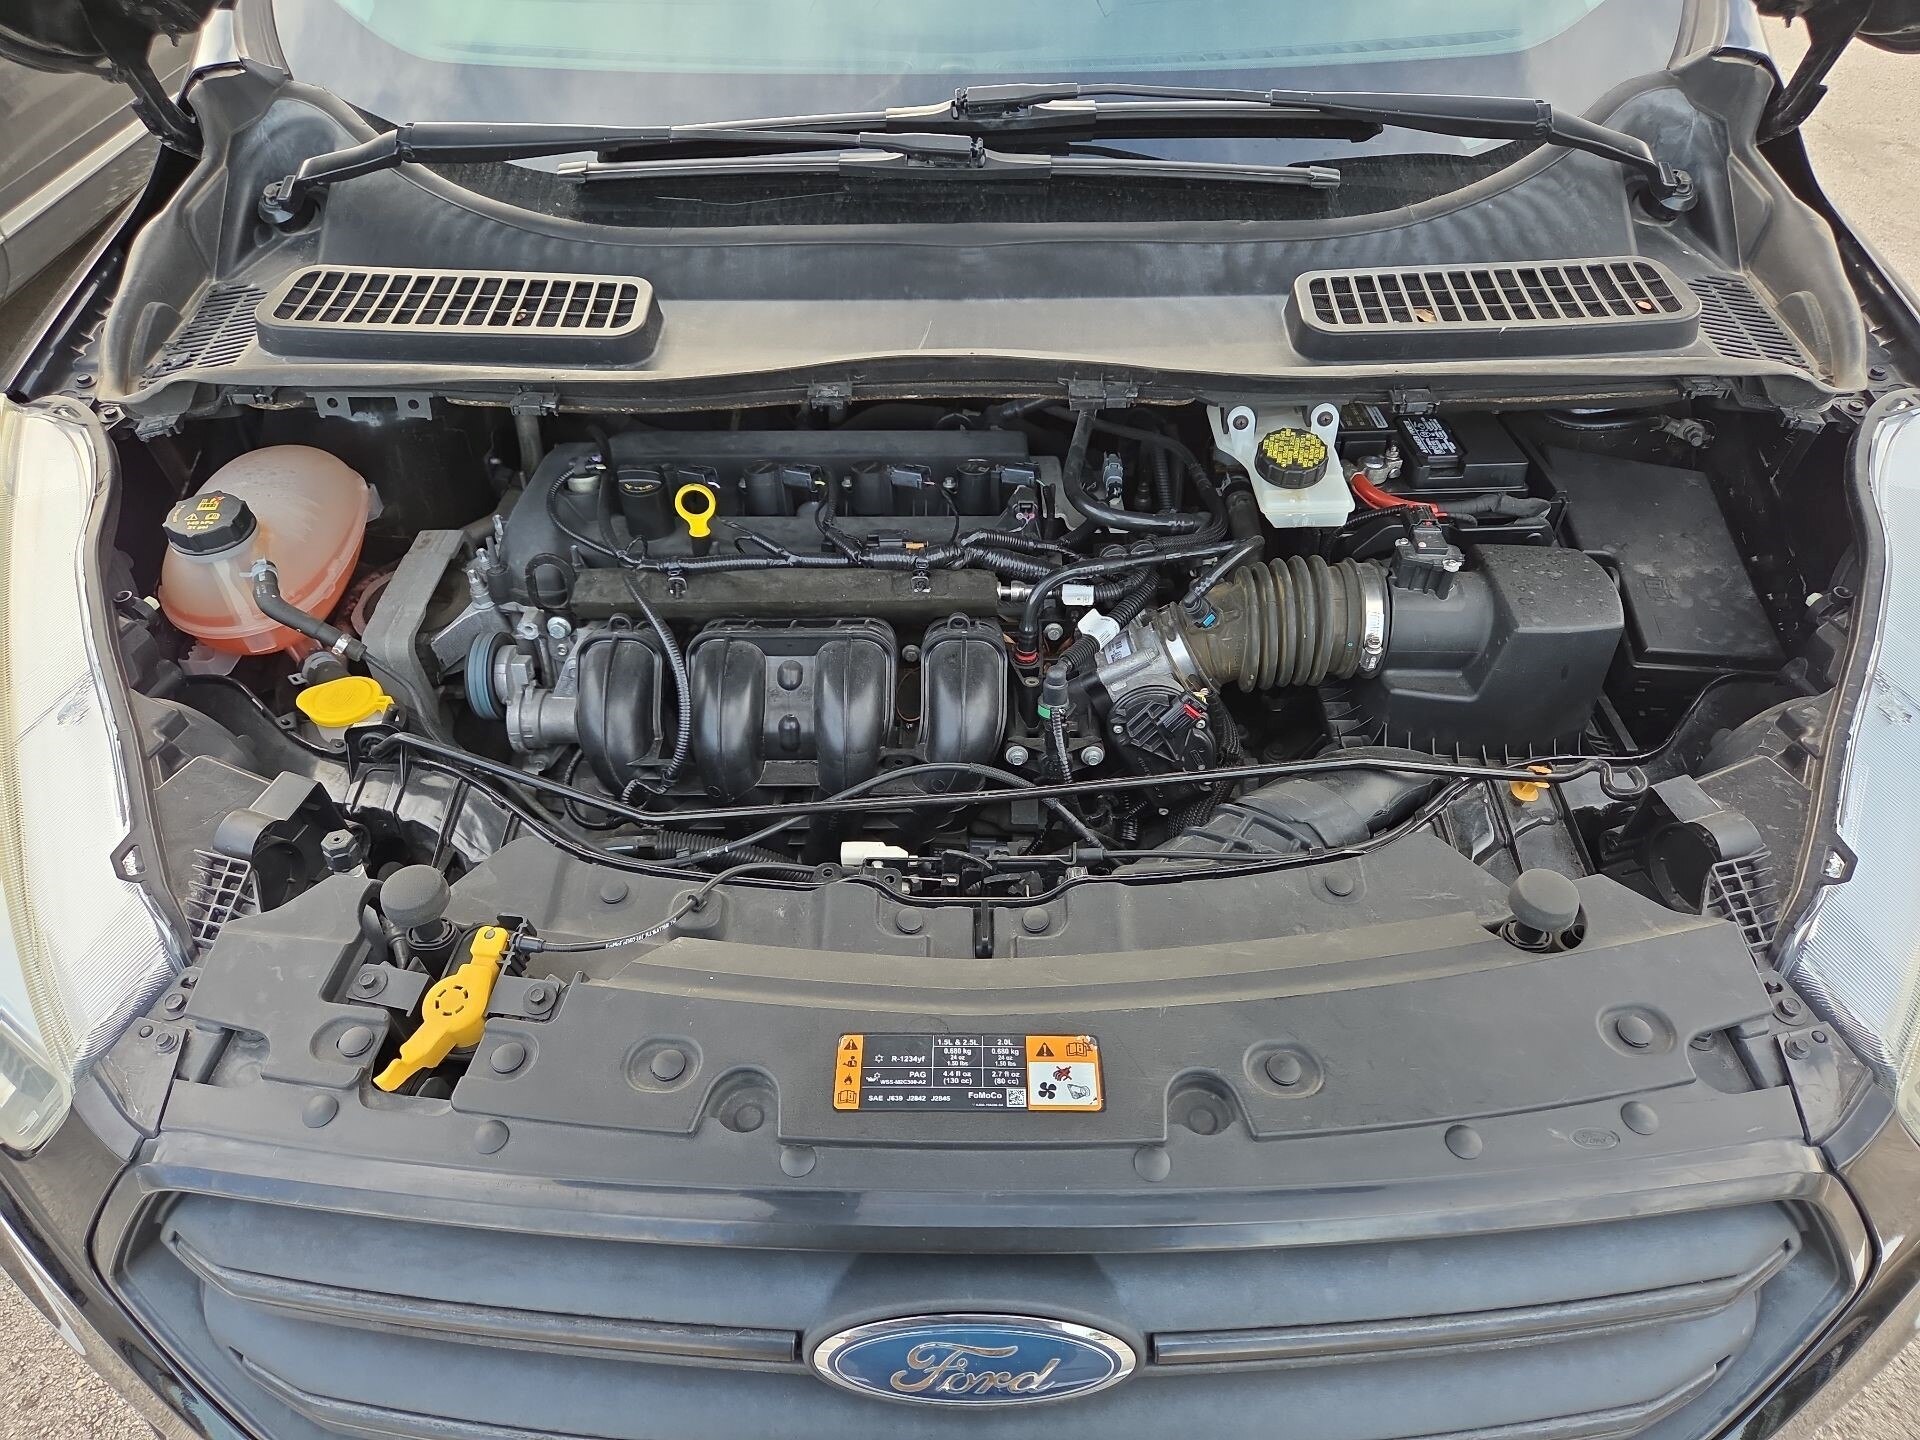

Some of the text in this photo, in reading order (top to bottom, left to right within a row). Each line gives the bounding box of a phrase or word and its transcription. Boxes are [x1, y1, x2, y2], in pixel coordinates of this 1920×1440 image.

[938, 1038, 979, 1046] 1.5L & 2.5L
[997, 1038, 1013, 1046] 2.0L
[963, 1048, 972, 1056] kg
[1011, 1048, 1020, 1056] kg
[891, 1055, 925, 1063] R-1234yf
[943, 1077, 972, 1085] (130 cc)
[890, 1341, 1061, 1394] Ford
